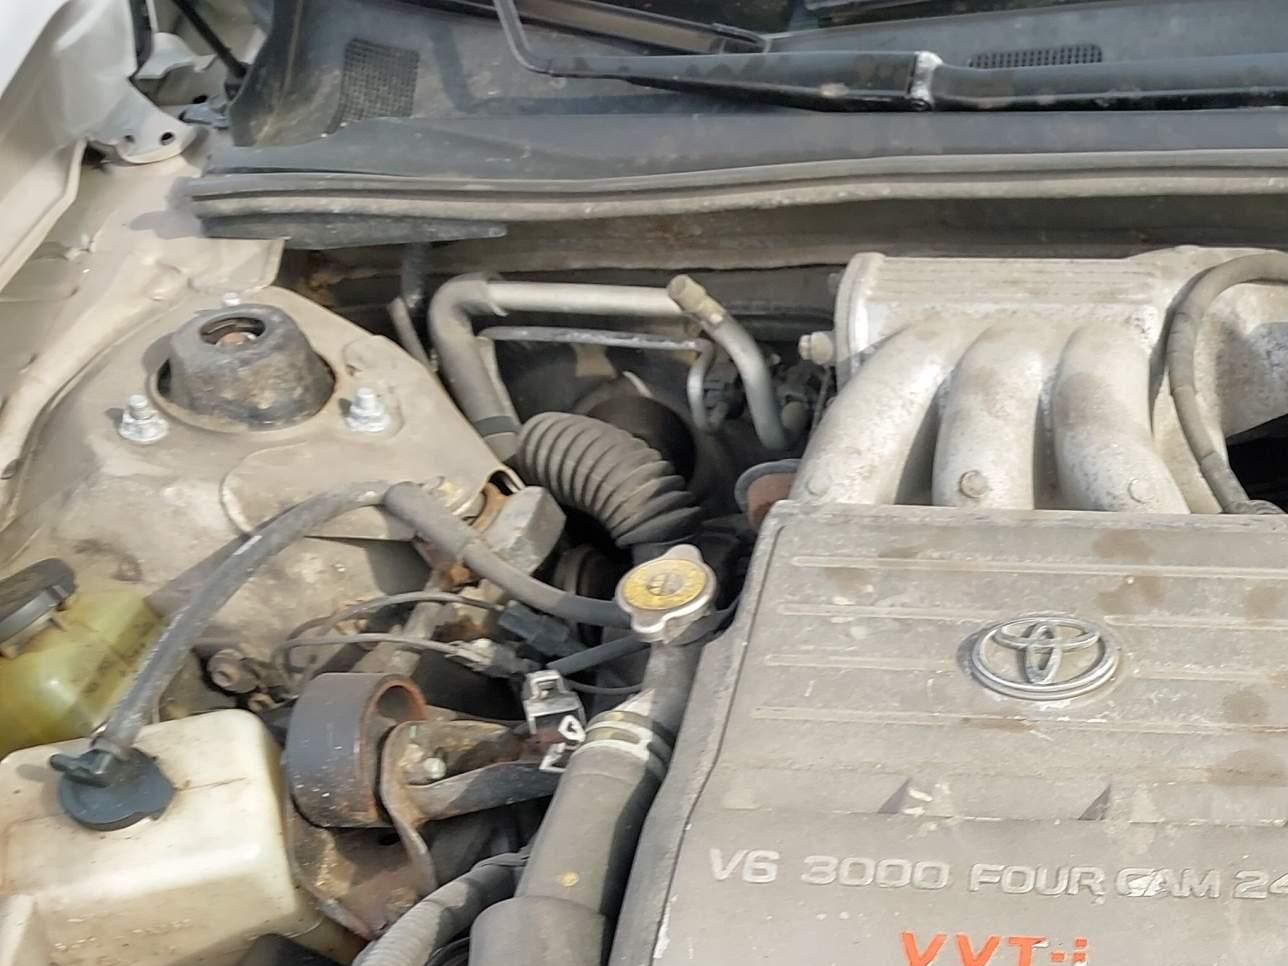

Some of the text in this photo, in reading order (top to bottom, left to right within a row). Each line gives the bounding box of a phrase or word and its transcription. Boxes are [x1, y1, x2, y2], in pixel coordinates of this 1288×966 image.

[708, 847, 780, 884] V6
[800, 854, 952, 891] 3000
[968, 861, 1105, 899] FOUR
[1114, 866, 1220, 900] CAM
